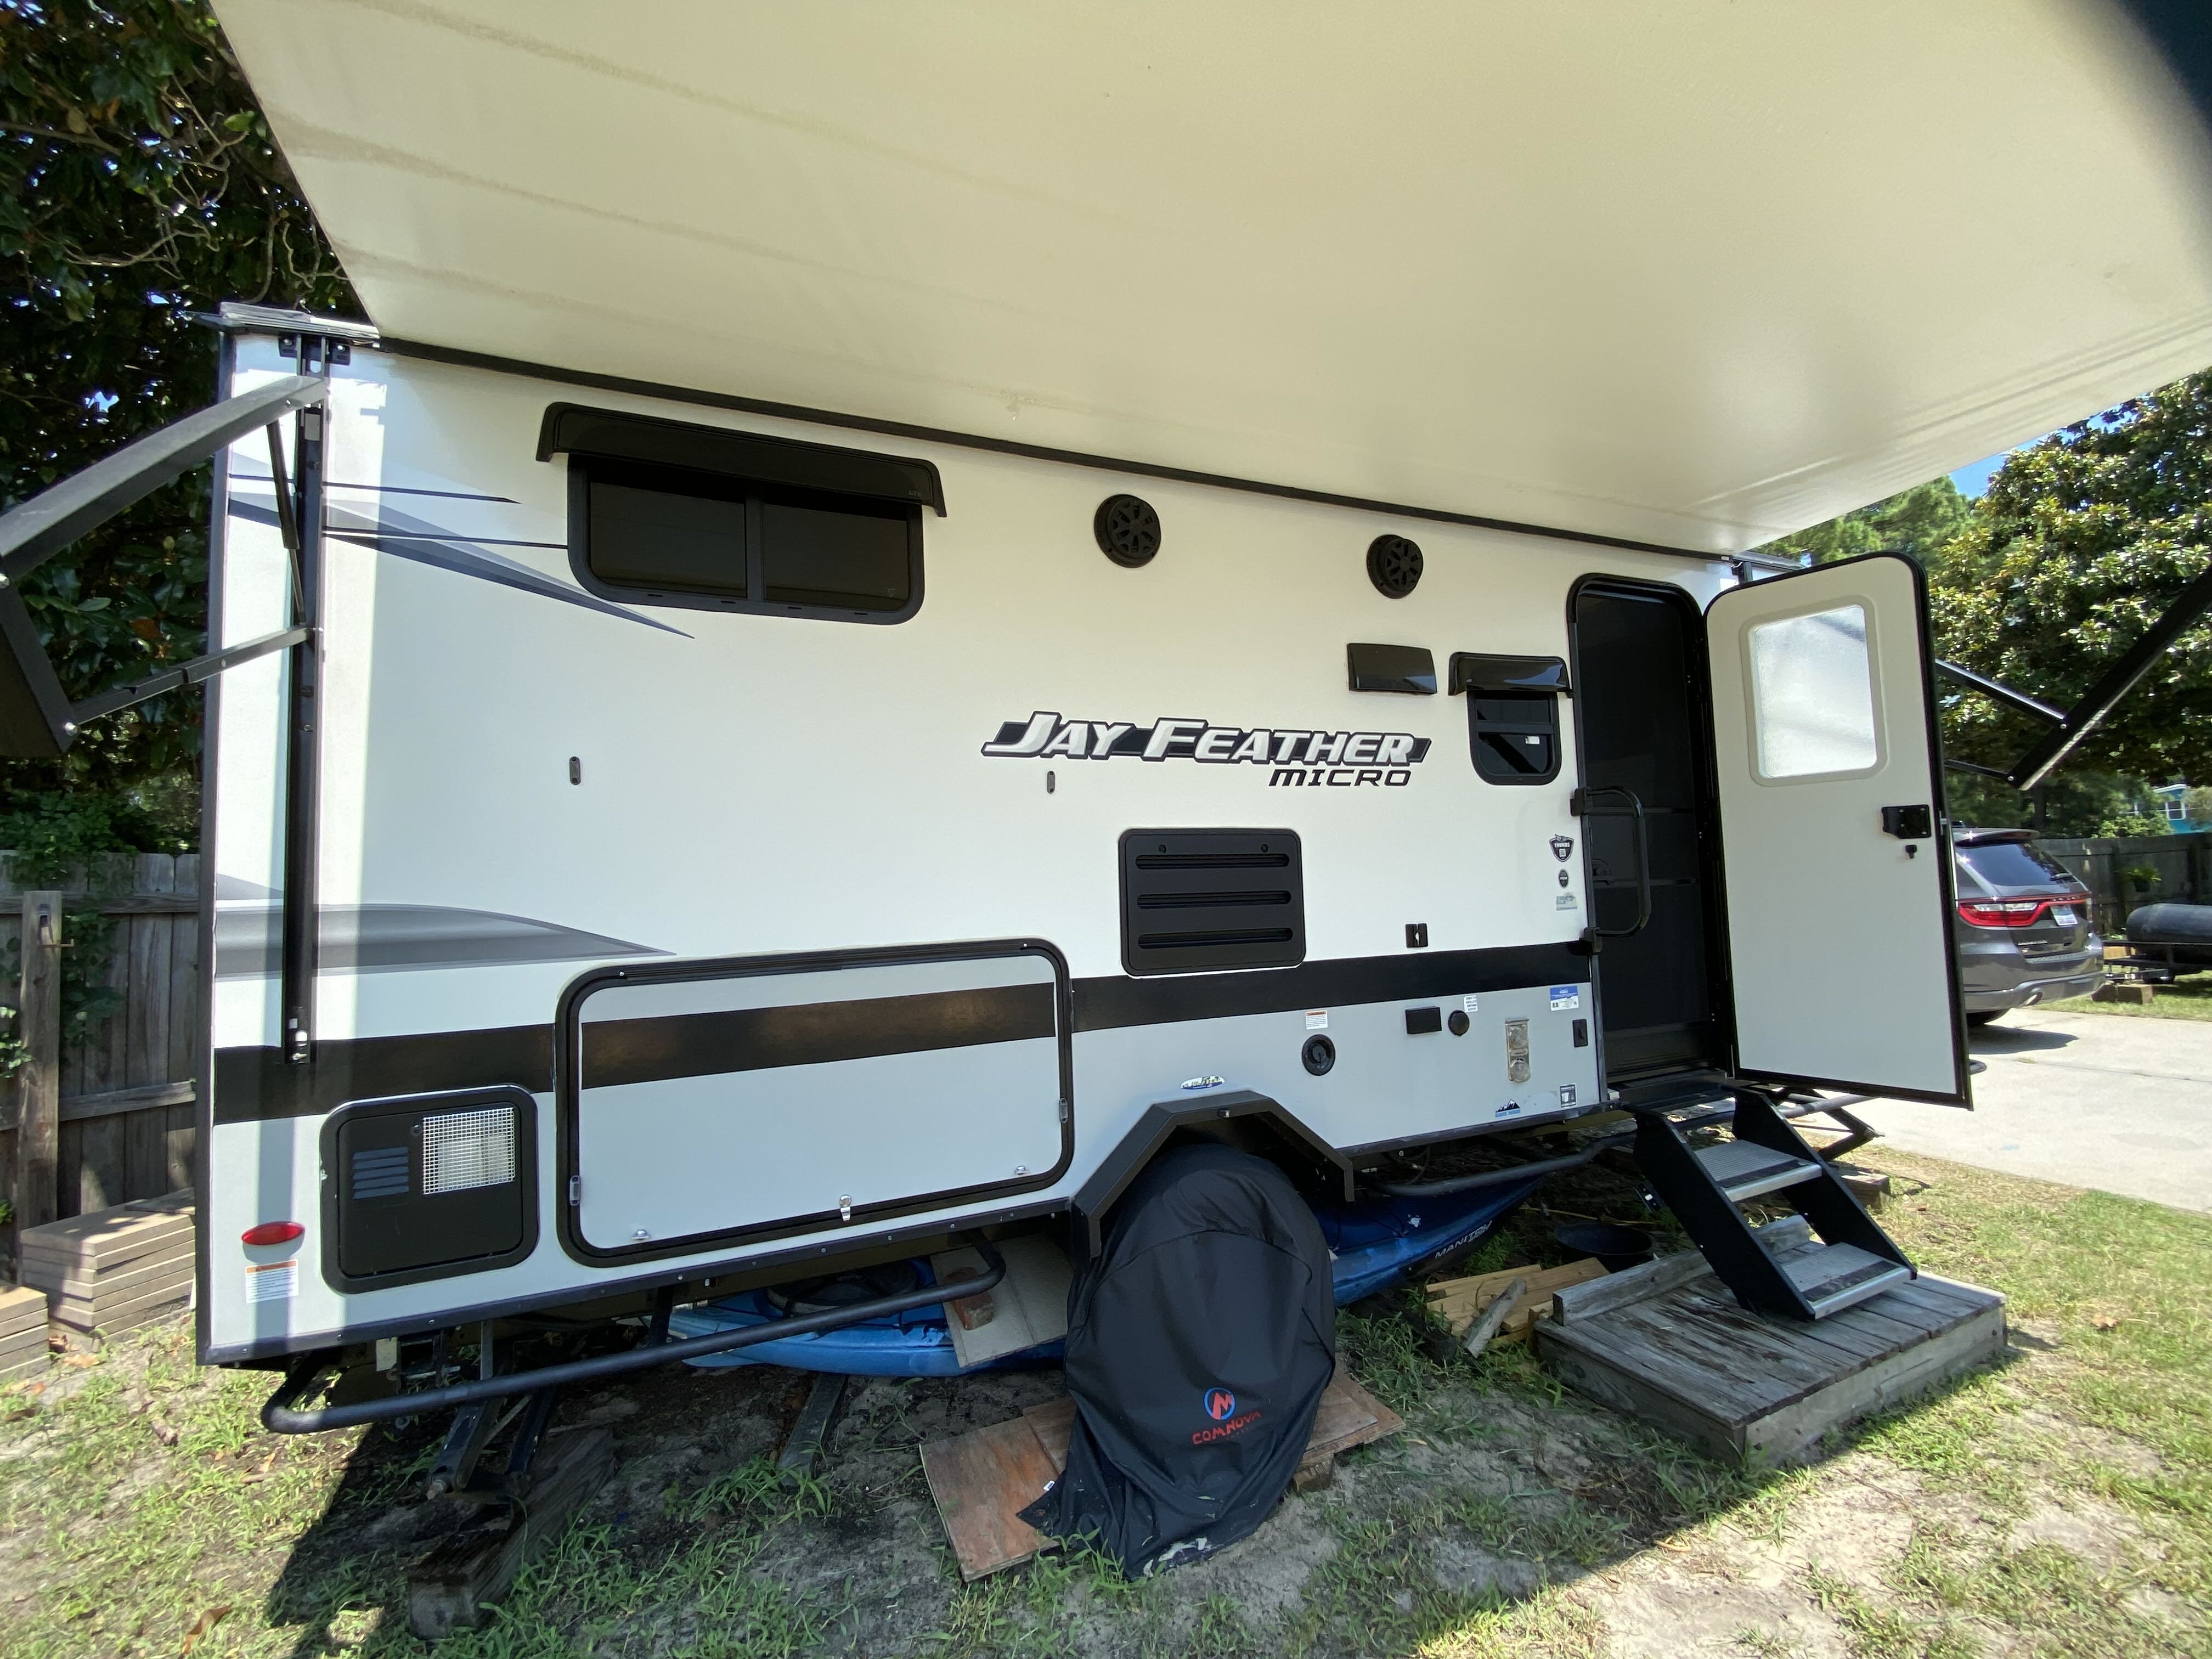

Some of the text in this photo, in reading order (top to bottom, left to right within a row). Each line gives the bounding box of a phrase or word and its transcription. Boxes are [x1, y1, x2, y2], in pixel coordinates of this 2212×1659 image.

[981, 711, 1417, 766] JAY FEATHER
[1268, 769, 1411, 787] MICRO
[1192, 1410, 1262, 1444] COMNOVA
